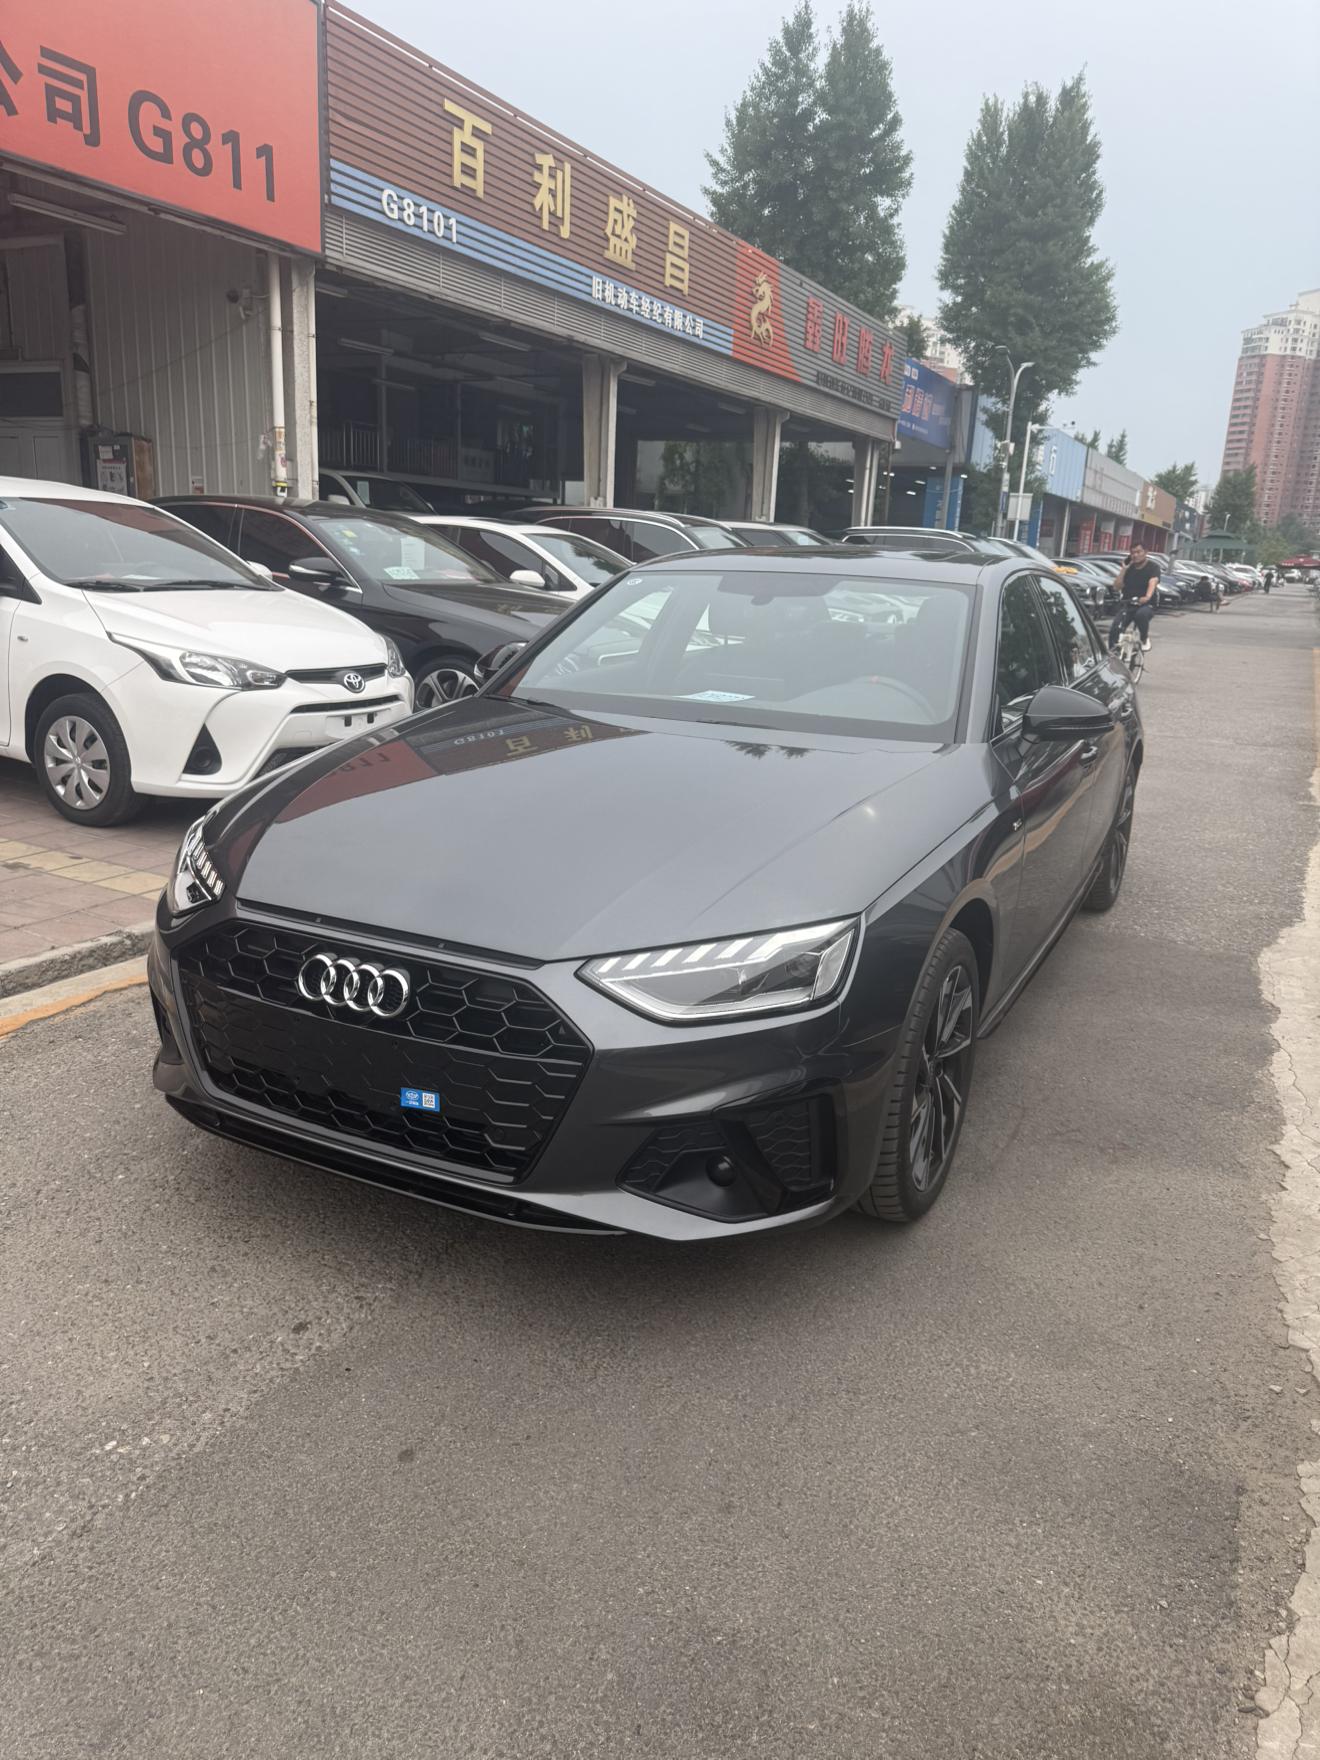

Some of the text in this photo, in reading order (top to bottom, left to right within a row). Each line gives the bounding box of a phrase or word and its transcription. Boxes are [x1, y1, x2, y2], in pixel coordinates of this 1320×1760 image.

[128, 90, 275, 203] G811
[381, 188, 458, 244] G8101
[443, 98, 690, 297] 百利盛昌
[592, 275, 704, 339] 旧机动车经纪有限公司
